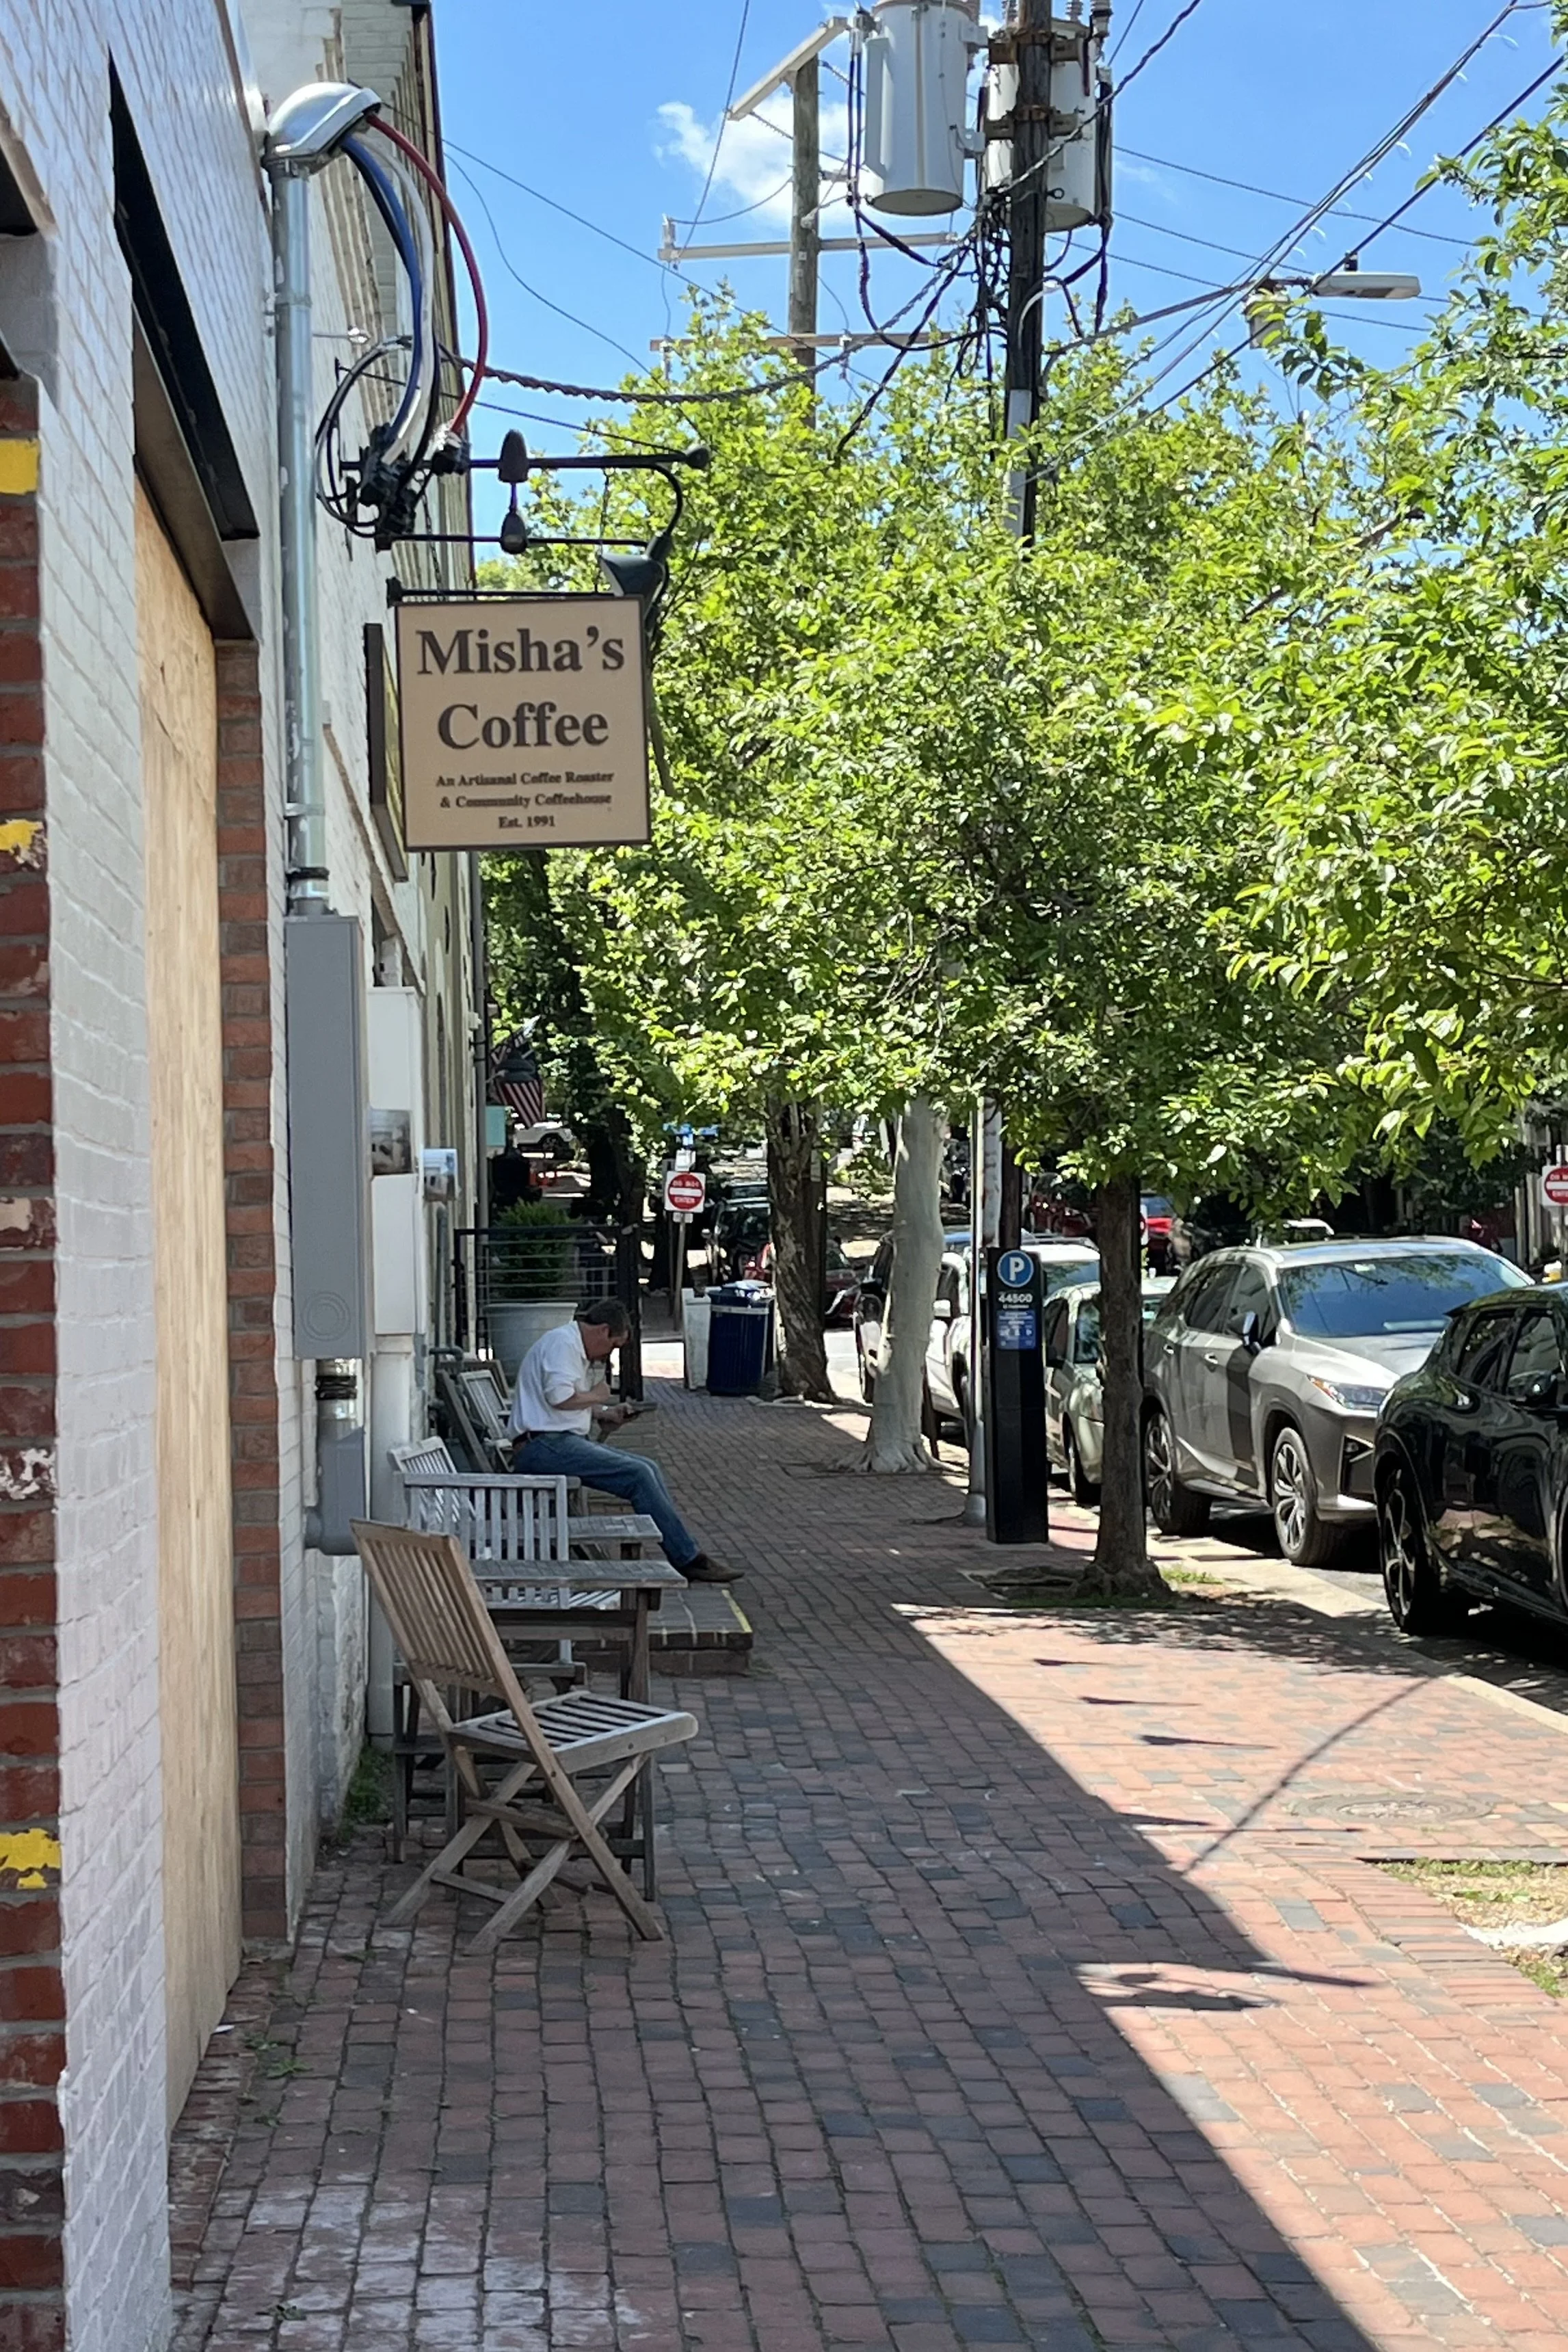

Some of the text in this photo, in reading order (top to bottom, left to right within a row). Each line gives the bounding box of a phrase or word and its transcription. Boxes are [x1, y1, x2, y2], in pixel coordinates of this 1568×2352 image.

[415, 625, 625, 675] Misha's
[437, 701, 609, 750] Coffee
[436, 771, 614, 787] An Artisanal Coffee Roaster
[440, 793, 612, 808] & Community Coffeehouse
[498, 815, 555, 829] Est. 1991
[1009, 1257, 1025, 1281] P
